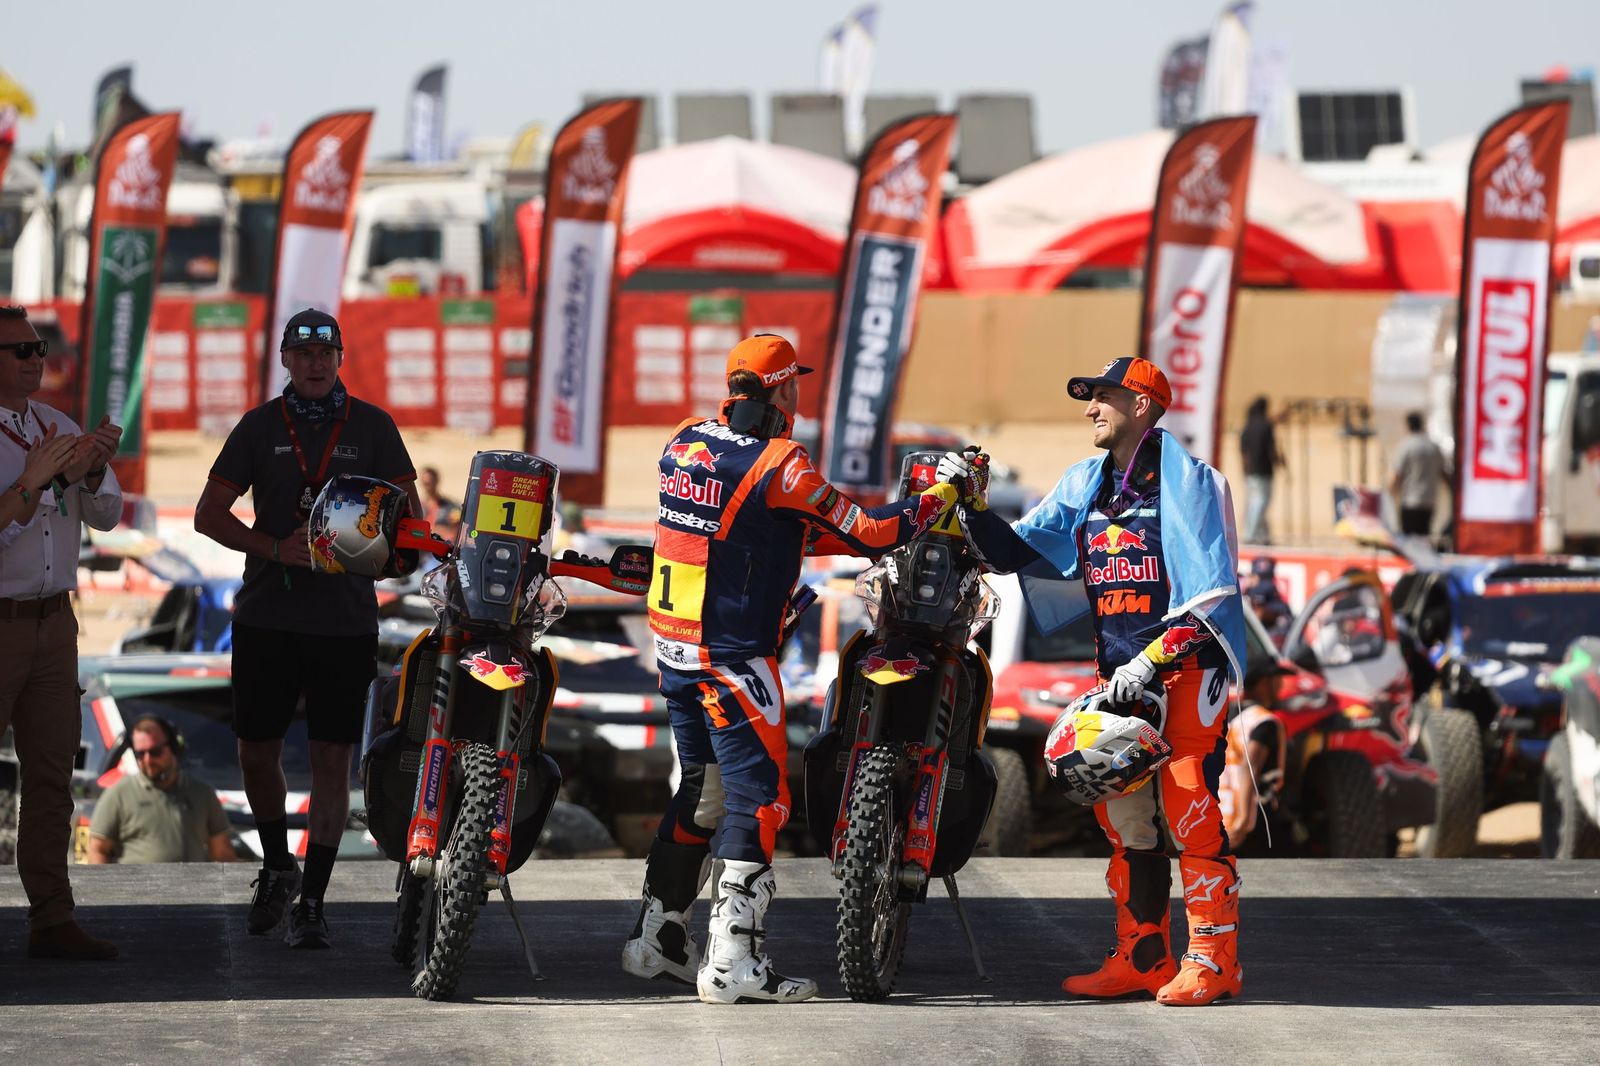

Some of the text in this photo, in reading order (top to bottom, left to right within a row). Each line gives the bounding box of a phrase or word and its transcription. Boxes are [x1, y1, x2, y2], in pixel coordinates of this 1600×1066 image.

[841, 247, 903, 482] DEFENDER
[1166, 288, 1208, 414] Hero
[763, 361, 799, 384] RACING
[1127, 378, 1150, 392] FACTORY
[1478, 286, 1530, 477] MOTUL
[511, 488, 527, 496] LIVE
[512, 476, 540, 486] DREAM.
[512, 483, 533, 491] DARE.
[660, 468, 723, 508] ed Bull
[500, 501, 516, 532] 1
[456, 559, 470, 588] KTM
[885, 556, 899, 584] KTM
[1084, 556, 1160, 586] Red Bull
[525, 572, 546, 602] KTM
[658, 565, 674, 612] 1
[1097, 589, 1151, 616] KTM
[676, 627, 693, 635] LIVE
[1140, 725, 1158, 742] Bull
[428, 749, 443, 804] MICHELIN
[1063, 768, 1100, 801] FASTER
